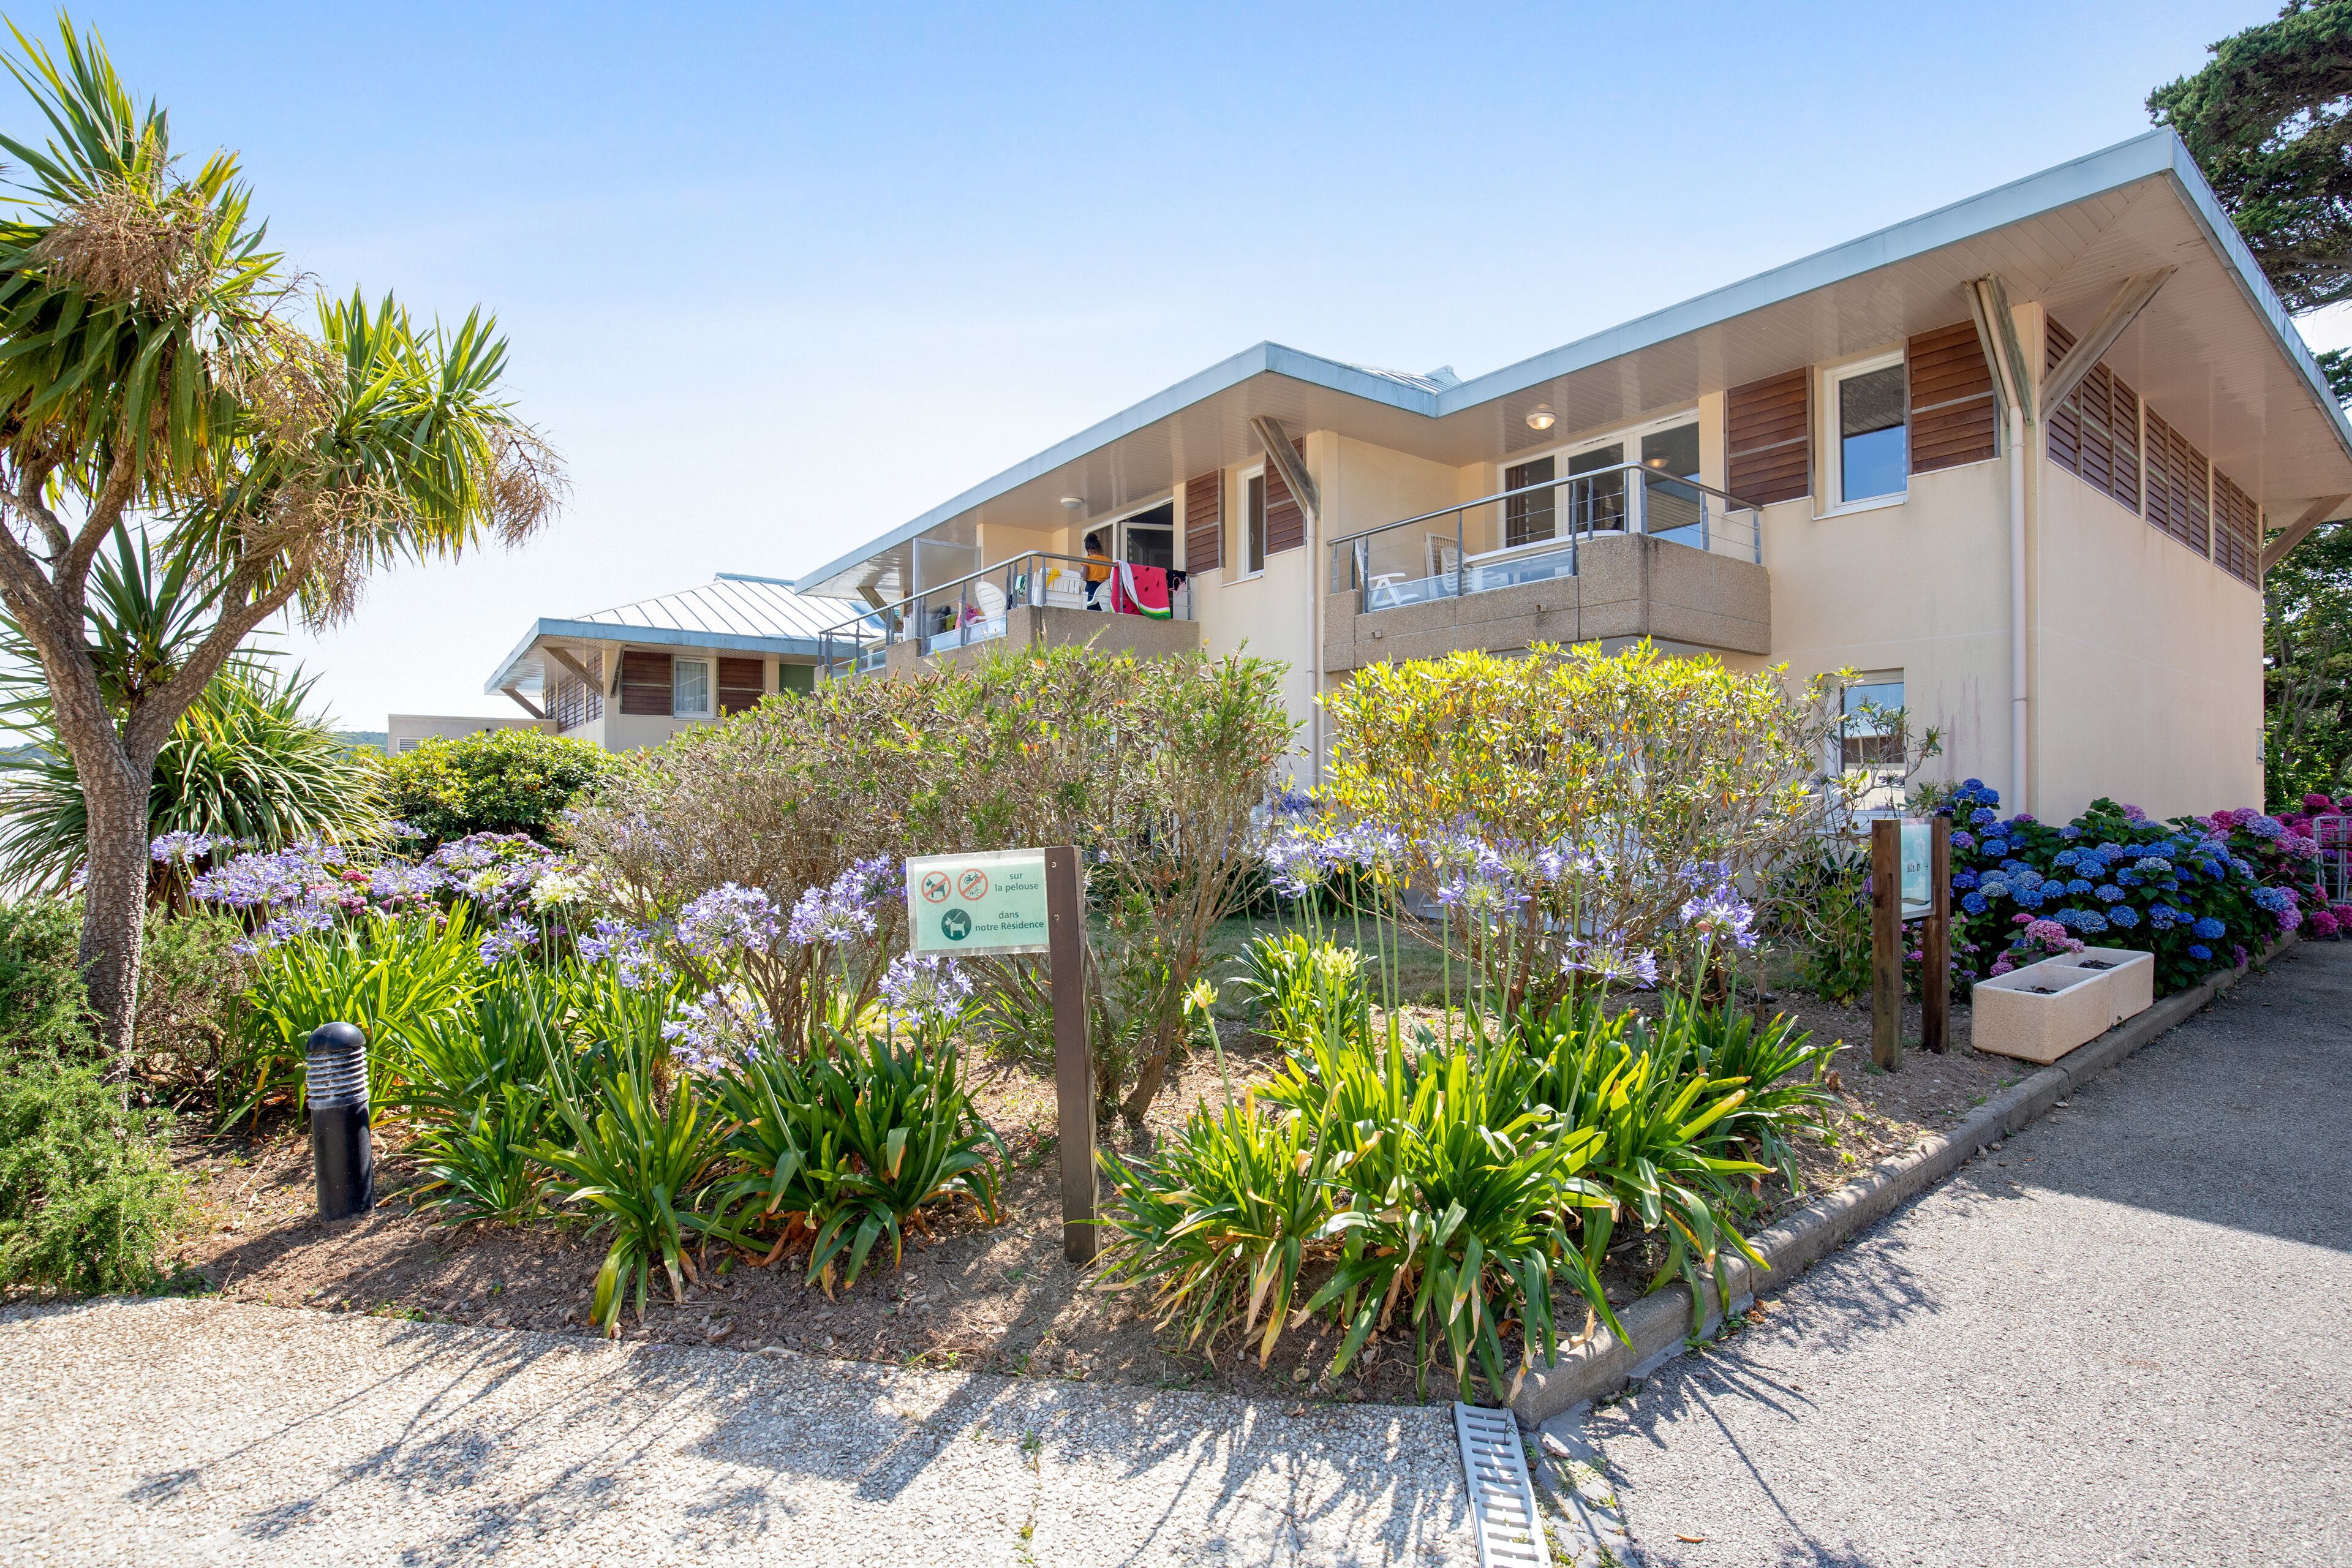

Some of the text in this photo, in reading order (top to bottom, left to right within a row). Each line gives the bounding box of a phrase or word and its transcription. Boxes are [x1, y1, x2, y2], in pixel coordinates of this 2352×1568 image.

[995, 882, 1039, 893] la pelouse
[1001, 921, 1044, 930] Résidence
